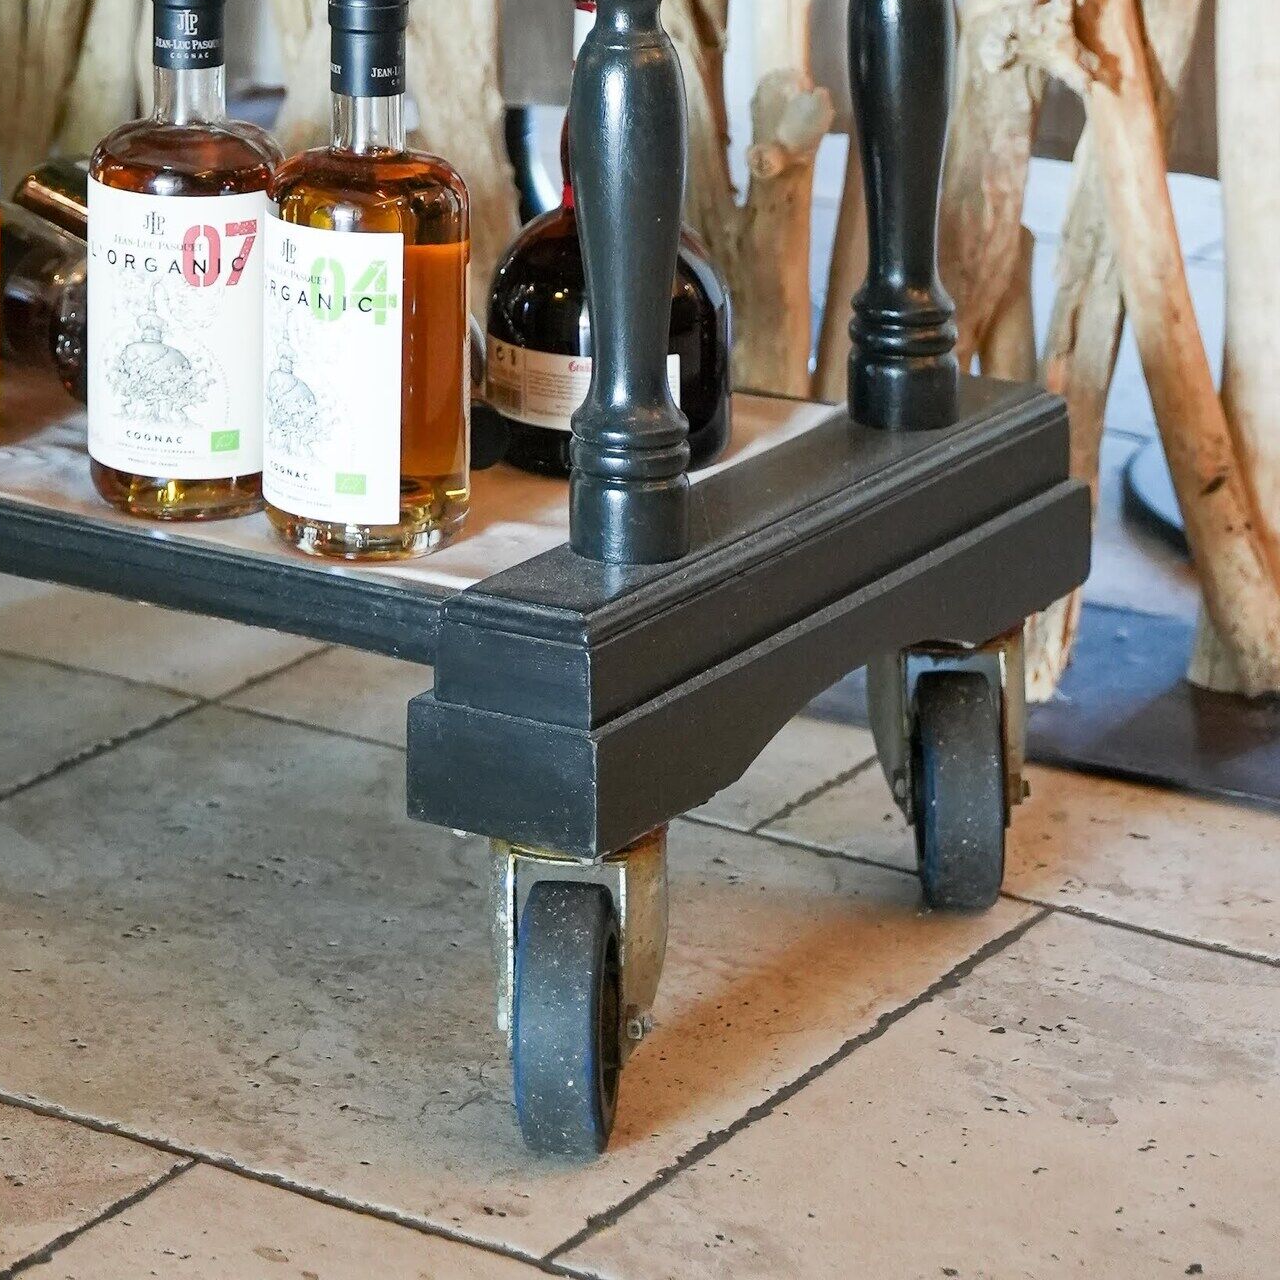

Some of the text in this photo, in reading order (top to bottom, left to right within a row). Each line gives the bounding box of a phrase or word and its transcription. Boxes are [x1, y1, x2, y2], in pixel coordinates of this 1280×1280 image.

[169, 51, 210, 59] COGNAC
[182, 219, 258, 289] 07
[309, 256, 398, 325] 04
[126, 429, 184, 445] COGNAC
